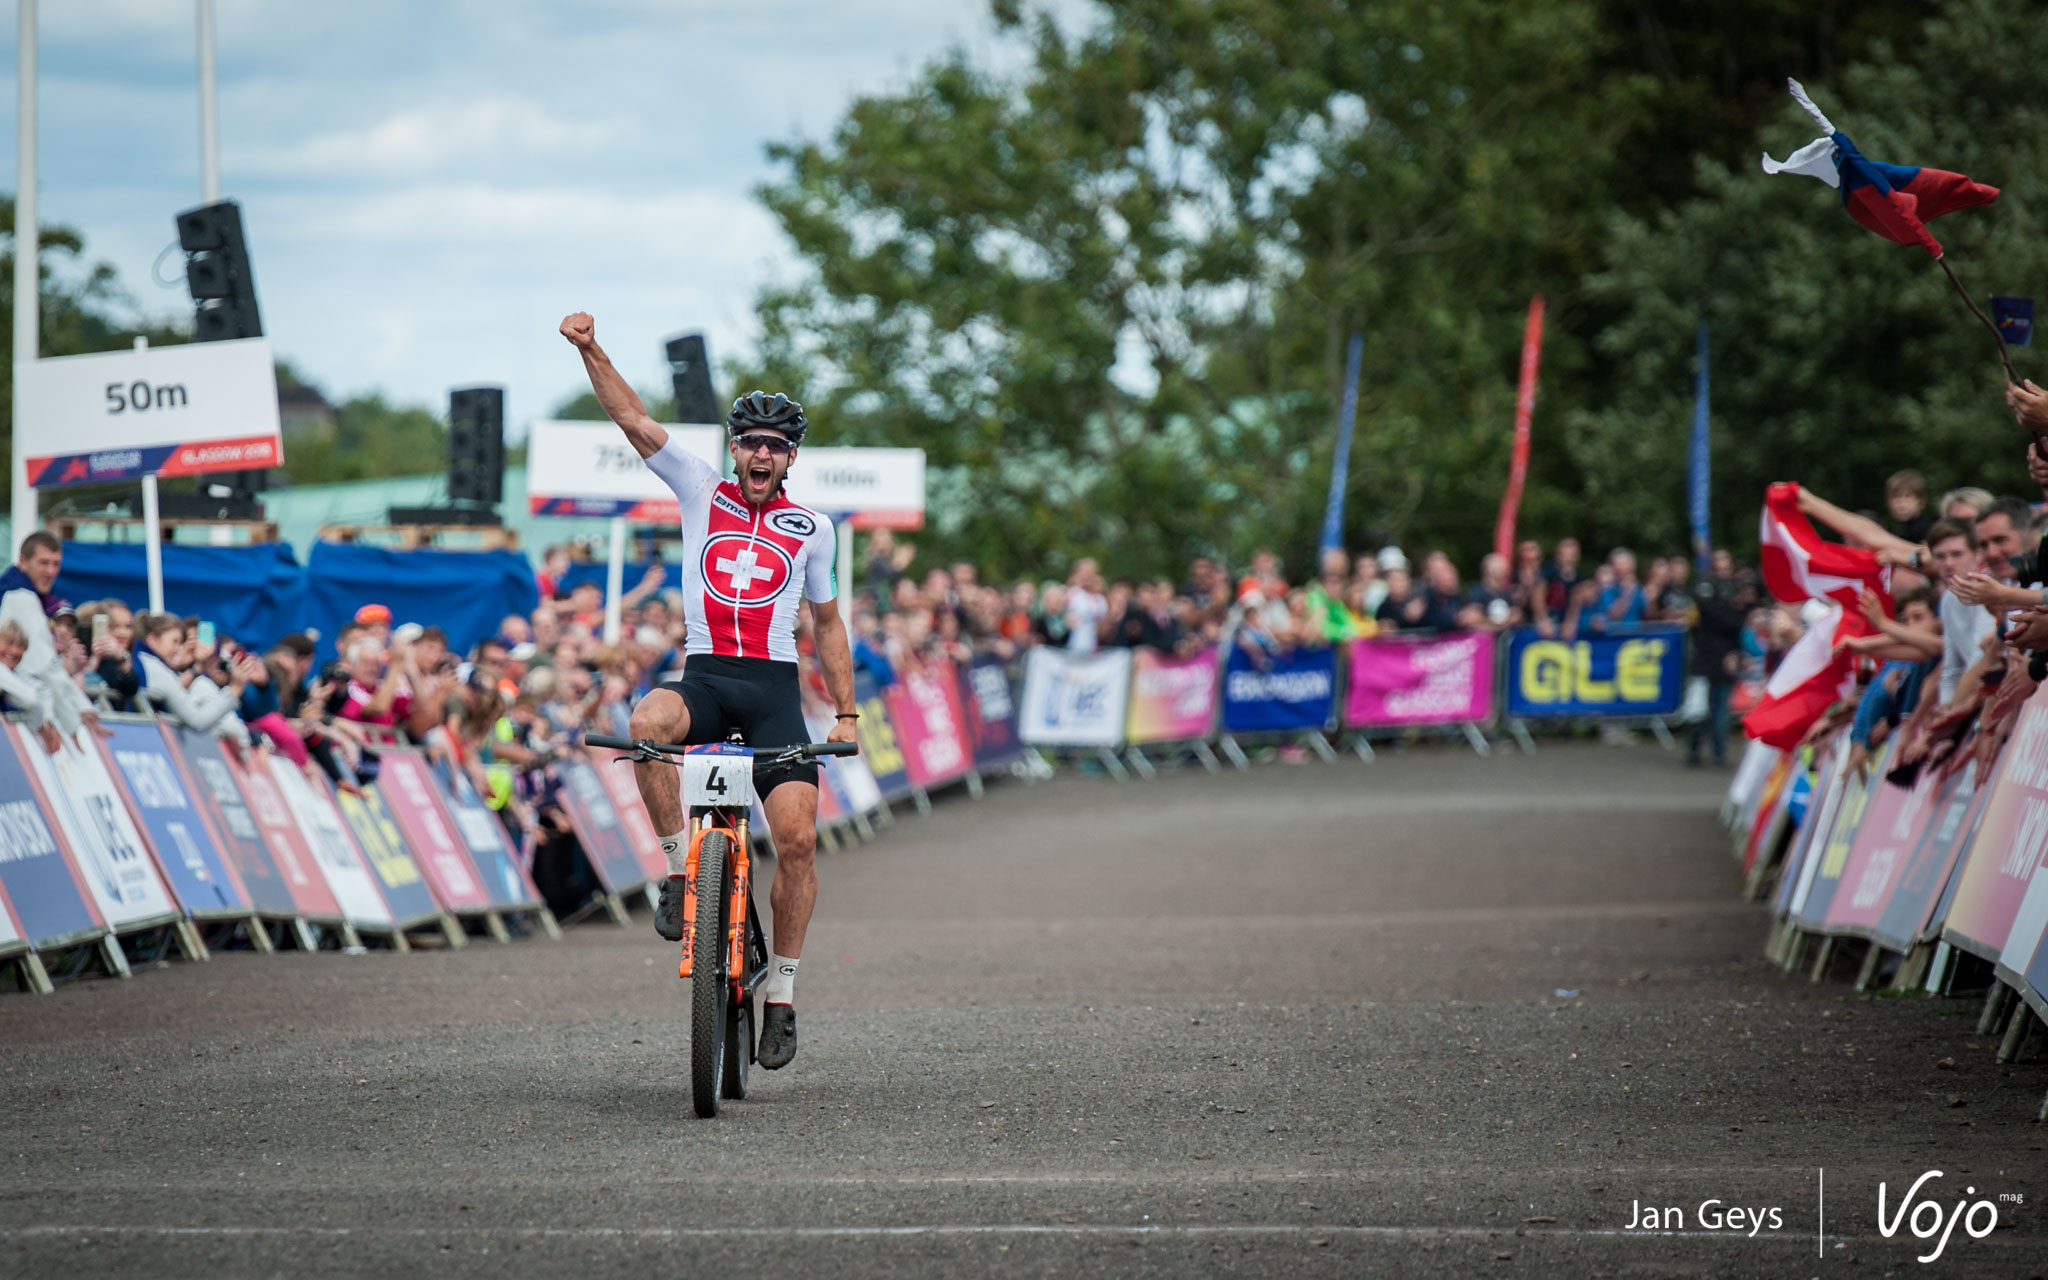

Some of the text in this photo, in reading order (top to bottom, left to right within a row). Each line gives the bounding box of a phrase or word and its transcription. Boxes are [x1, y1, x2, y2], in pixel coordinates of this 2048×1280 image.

[105, 380, 189, 414] 50m
[714, 495, 748, 519] BMC
[705, 765, 728, 796] 4
